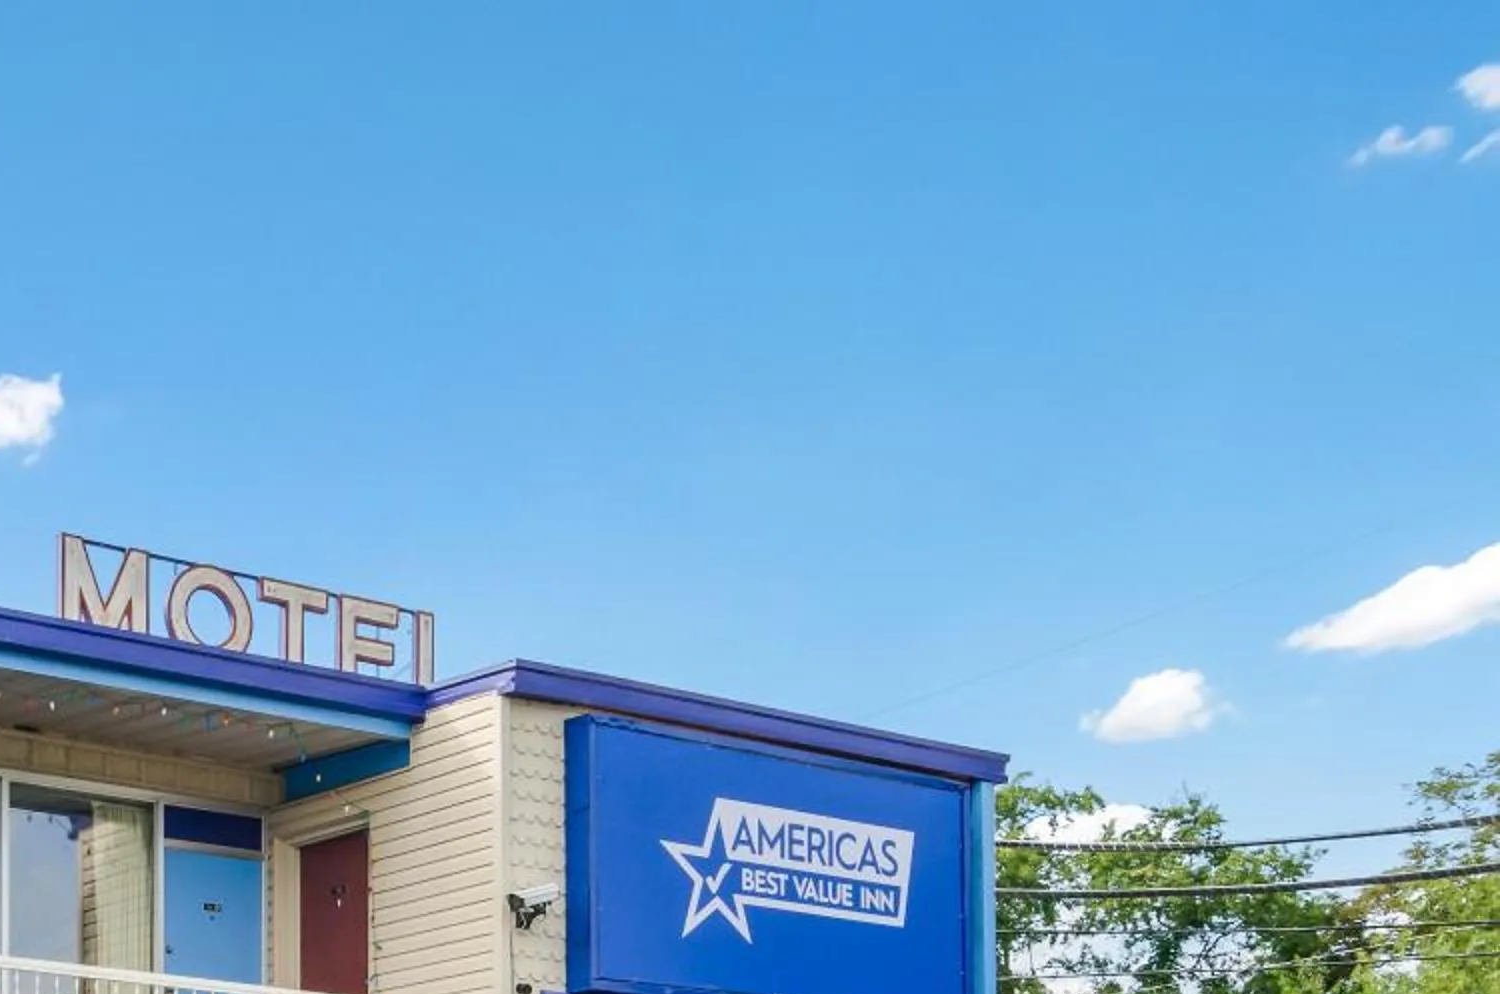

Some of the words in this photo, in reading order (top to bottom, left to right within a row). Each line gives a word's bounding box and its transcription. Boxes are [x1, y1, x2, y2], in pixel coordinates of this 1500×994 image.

[732, 816, 899, 878] AMERICAS
[742, 867, 789, 896] BEST
[792, 875, 853, 908] VALUE
[860, 886, 895, 913] INN
